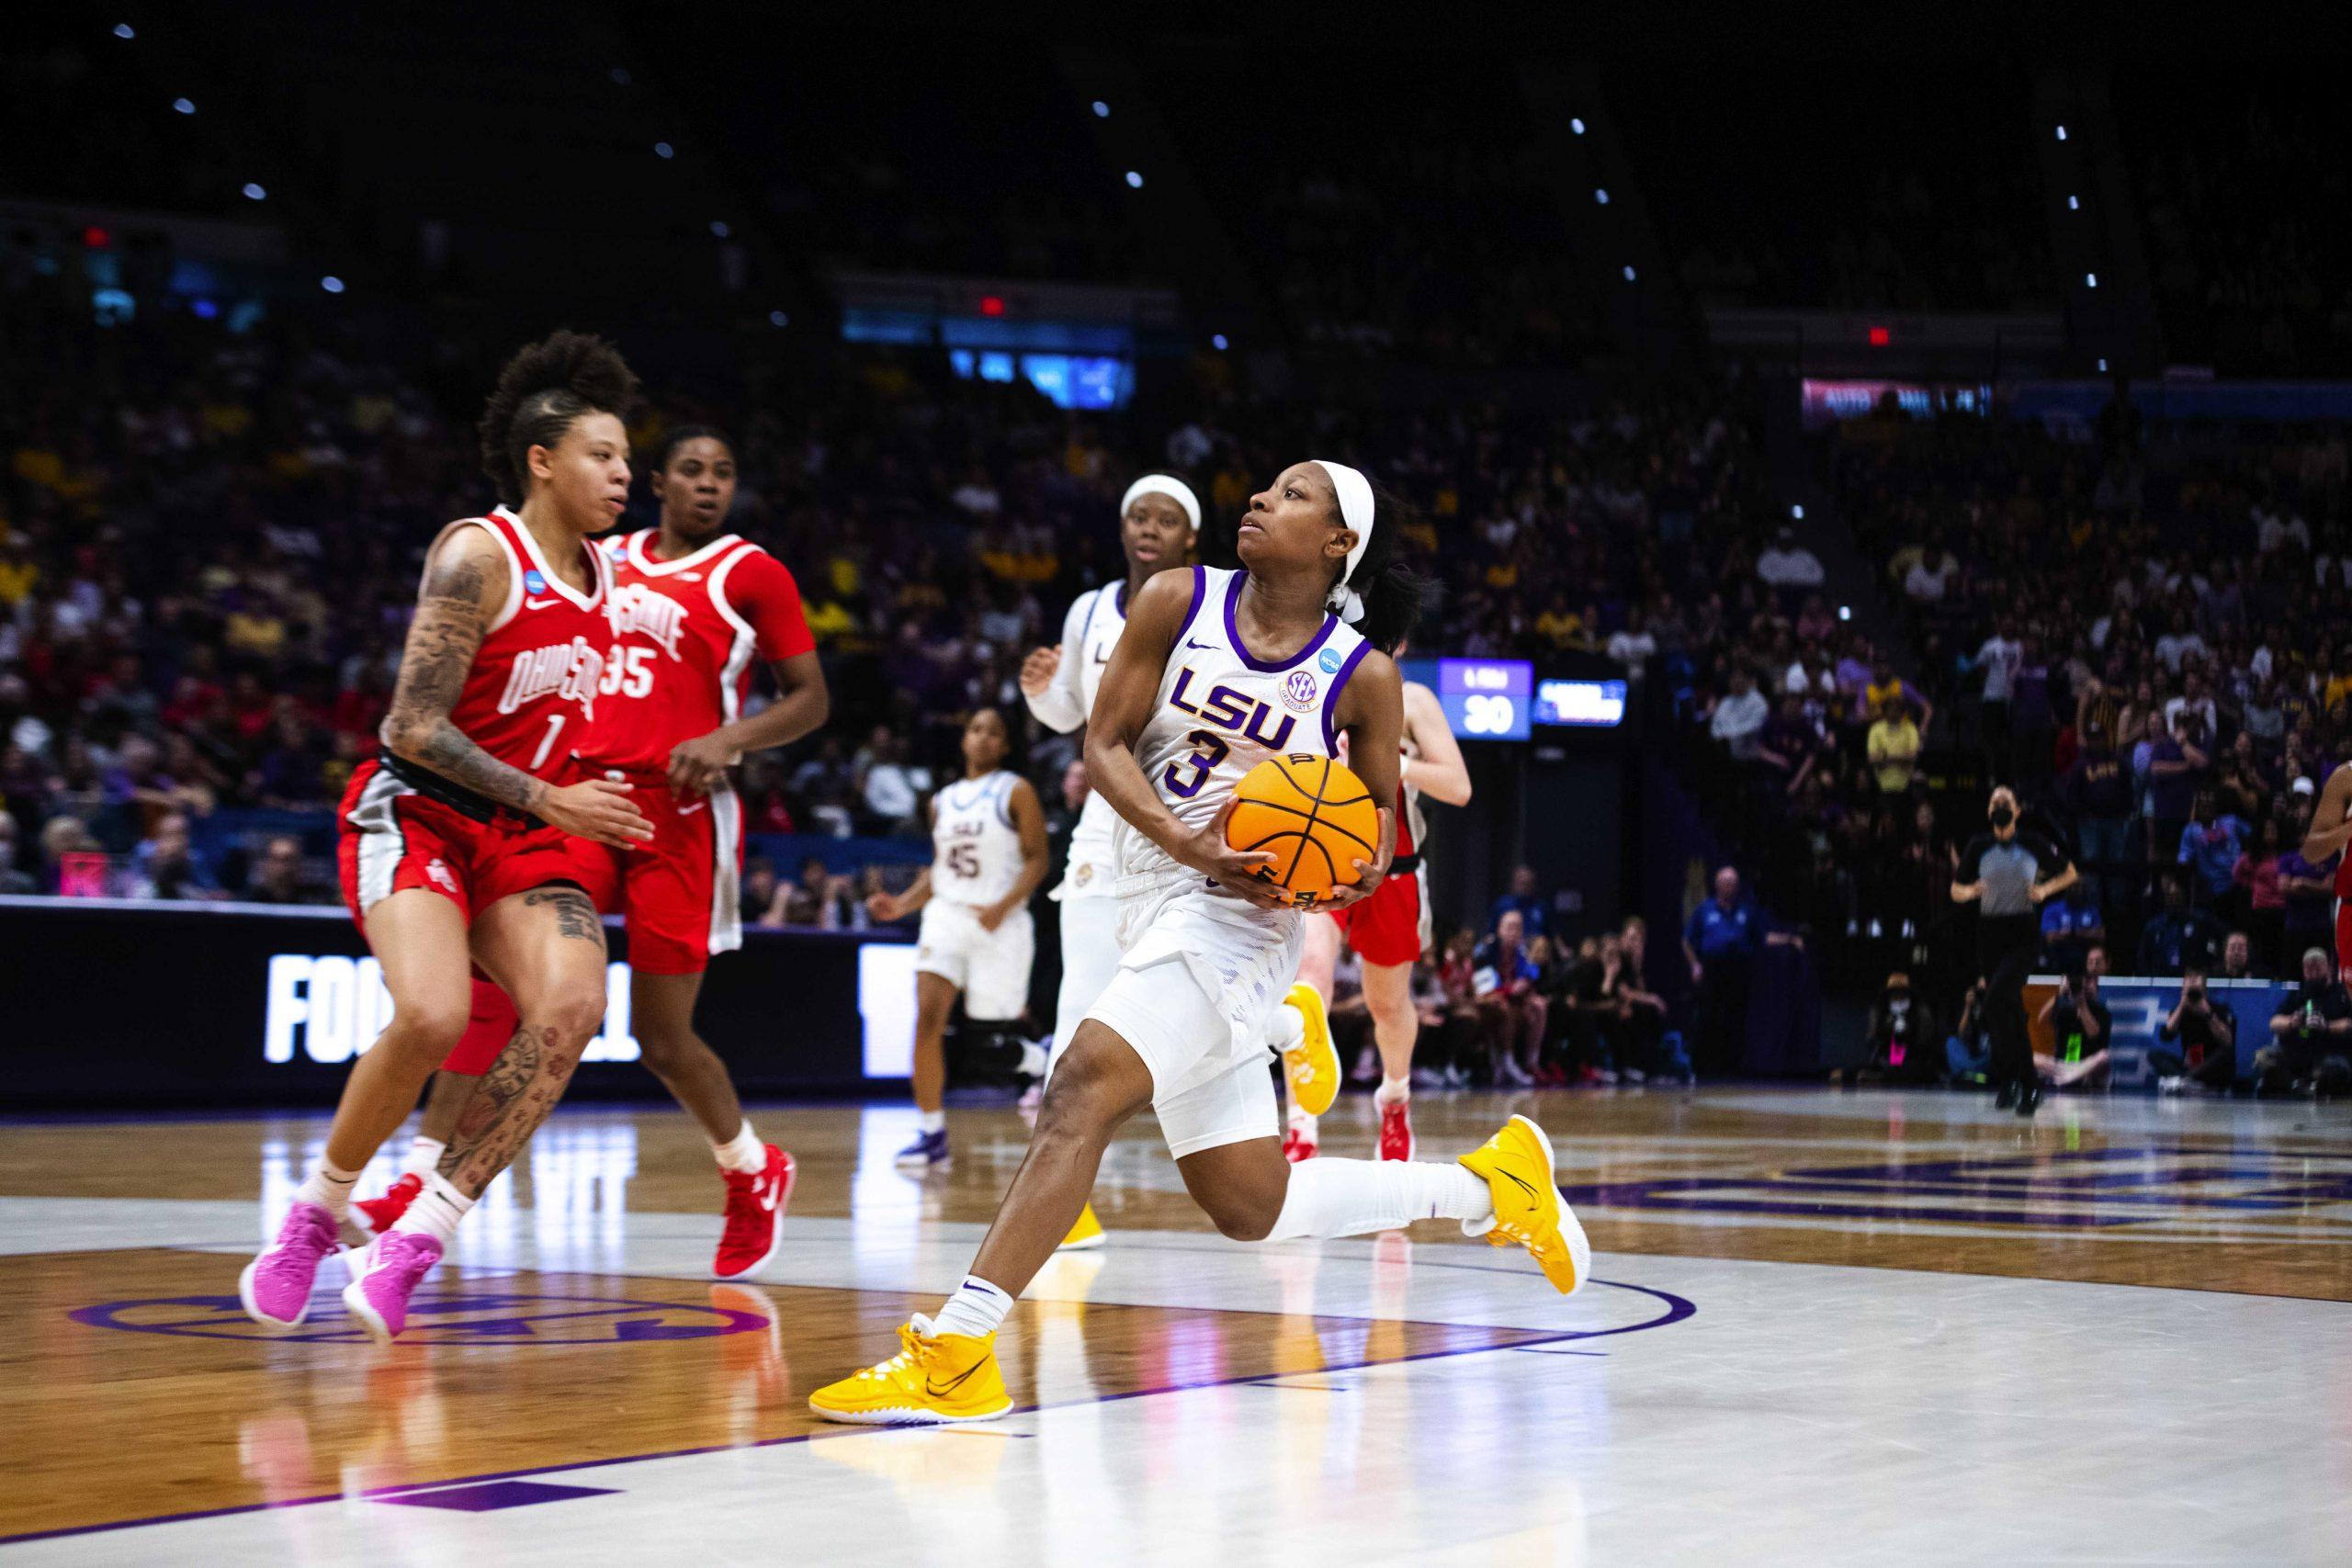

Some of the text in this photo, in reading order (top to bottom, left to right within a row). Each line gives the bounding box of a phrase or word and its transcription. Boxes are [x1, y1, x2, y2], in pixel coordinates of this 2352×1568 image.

[599, 644, 657, 698] 35
[1288, 672, 1316, 702] SEC
[1170, 666, 1297, 752] LSU
[1281, 689, 1312, 711] GRADUATE
[529, 714, 566, 770] 1
[1163, 728, 1230, 799] 3
